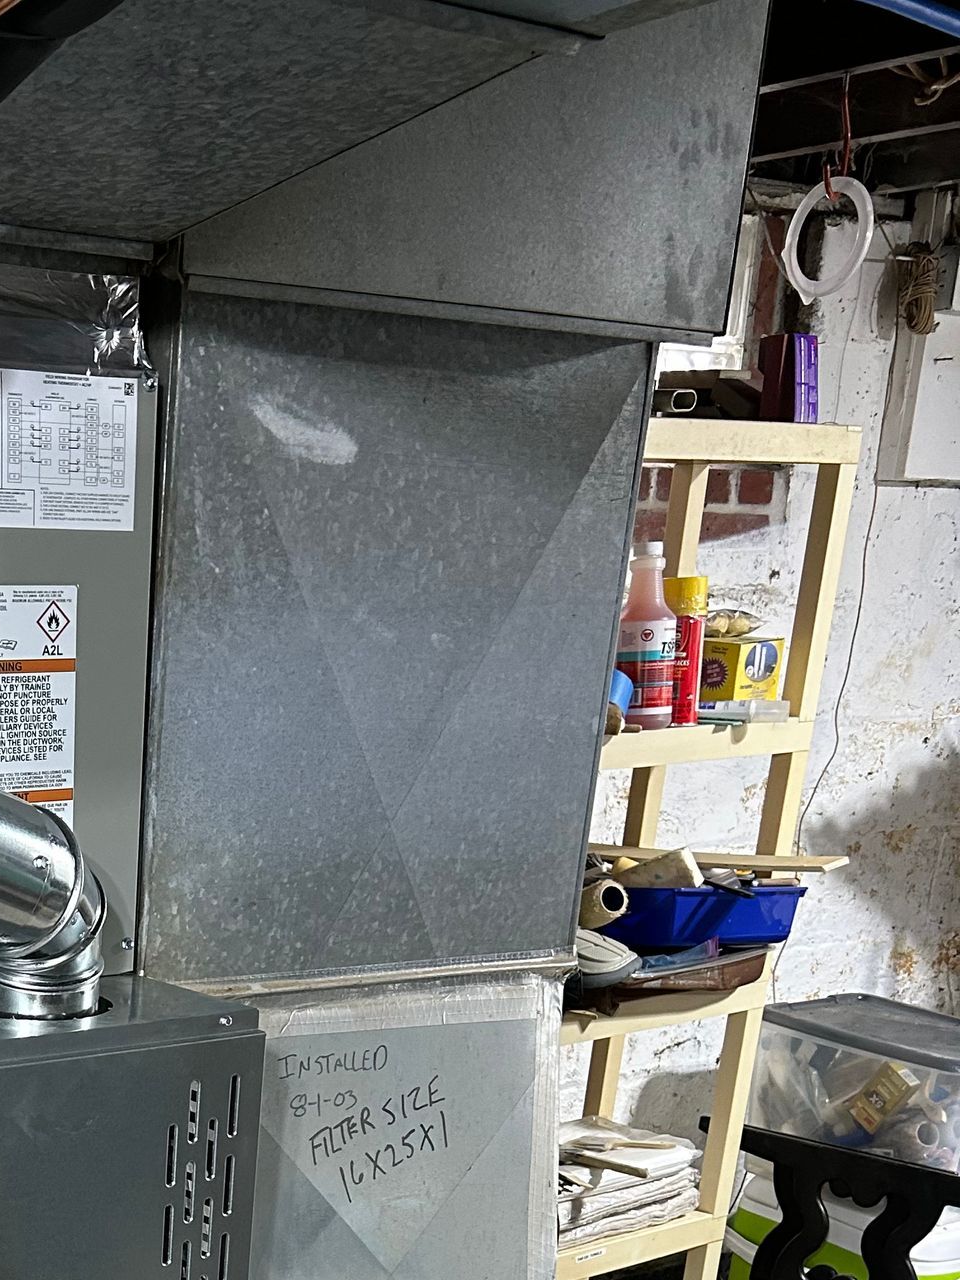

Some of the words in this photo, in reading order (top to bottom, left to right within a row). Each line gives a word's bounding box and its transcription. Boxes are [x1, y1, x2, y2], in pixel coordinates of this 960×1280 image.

[42, 645, 63, 656] A2L
[1, 675, 50, 684] REFRIGERANT
[21, 683, 51, 691] TRAINED
[13, 691, 51, 699] PUNCTURE
[20, 699, 30, 707] OF
[31, 698, 68, 706] PROPERLY
[20, 707, 31, 715] OR
[32, 706, 55, 715] LOCAL
[20, 714, 41, 723] GUIDE
[23, 722, 54, 730] DEVICES
[6, 730, 37, 739] IGNITION
[38, 729, 67, 737] SOURCE
[23, 745, 47, 754] LISTED
[33, 753, 48, 761] SEE
[278, 1045, 388, 1080] INSTALLED
[290, 1089, 358, 1117] 8-1-03
[308, 1106, 376, 1166] FILTER
[381, 1075, 446, 1126] SIZE
